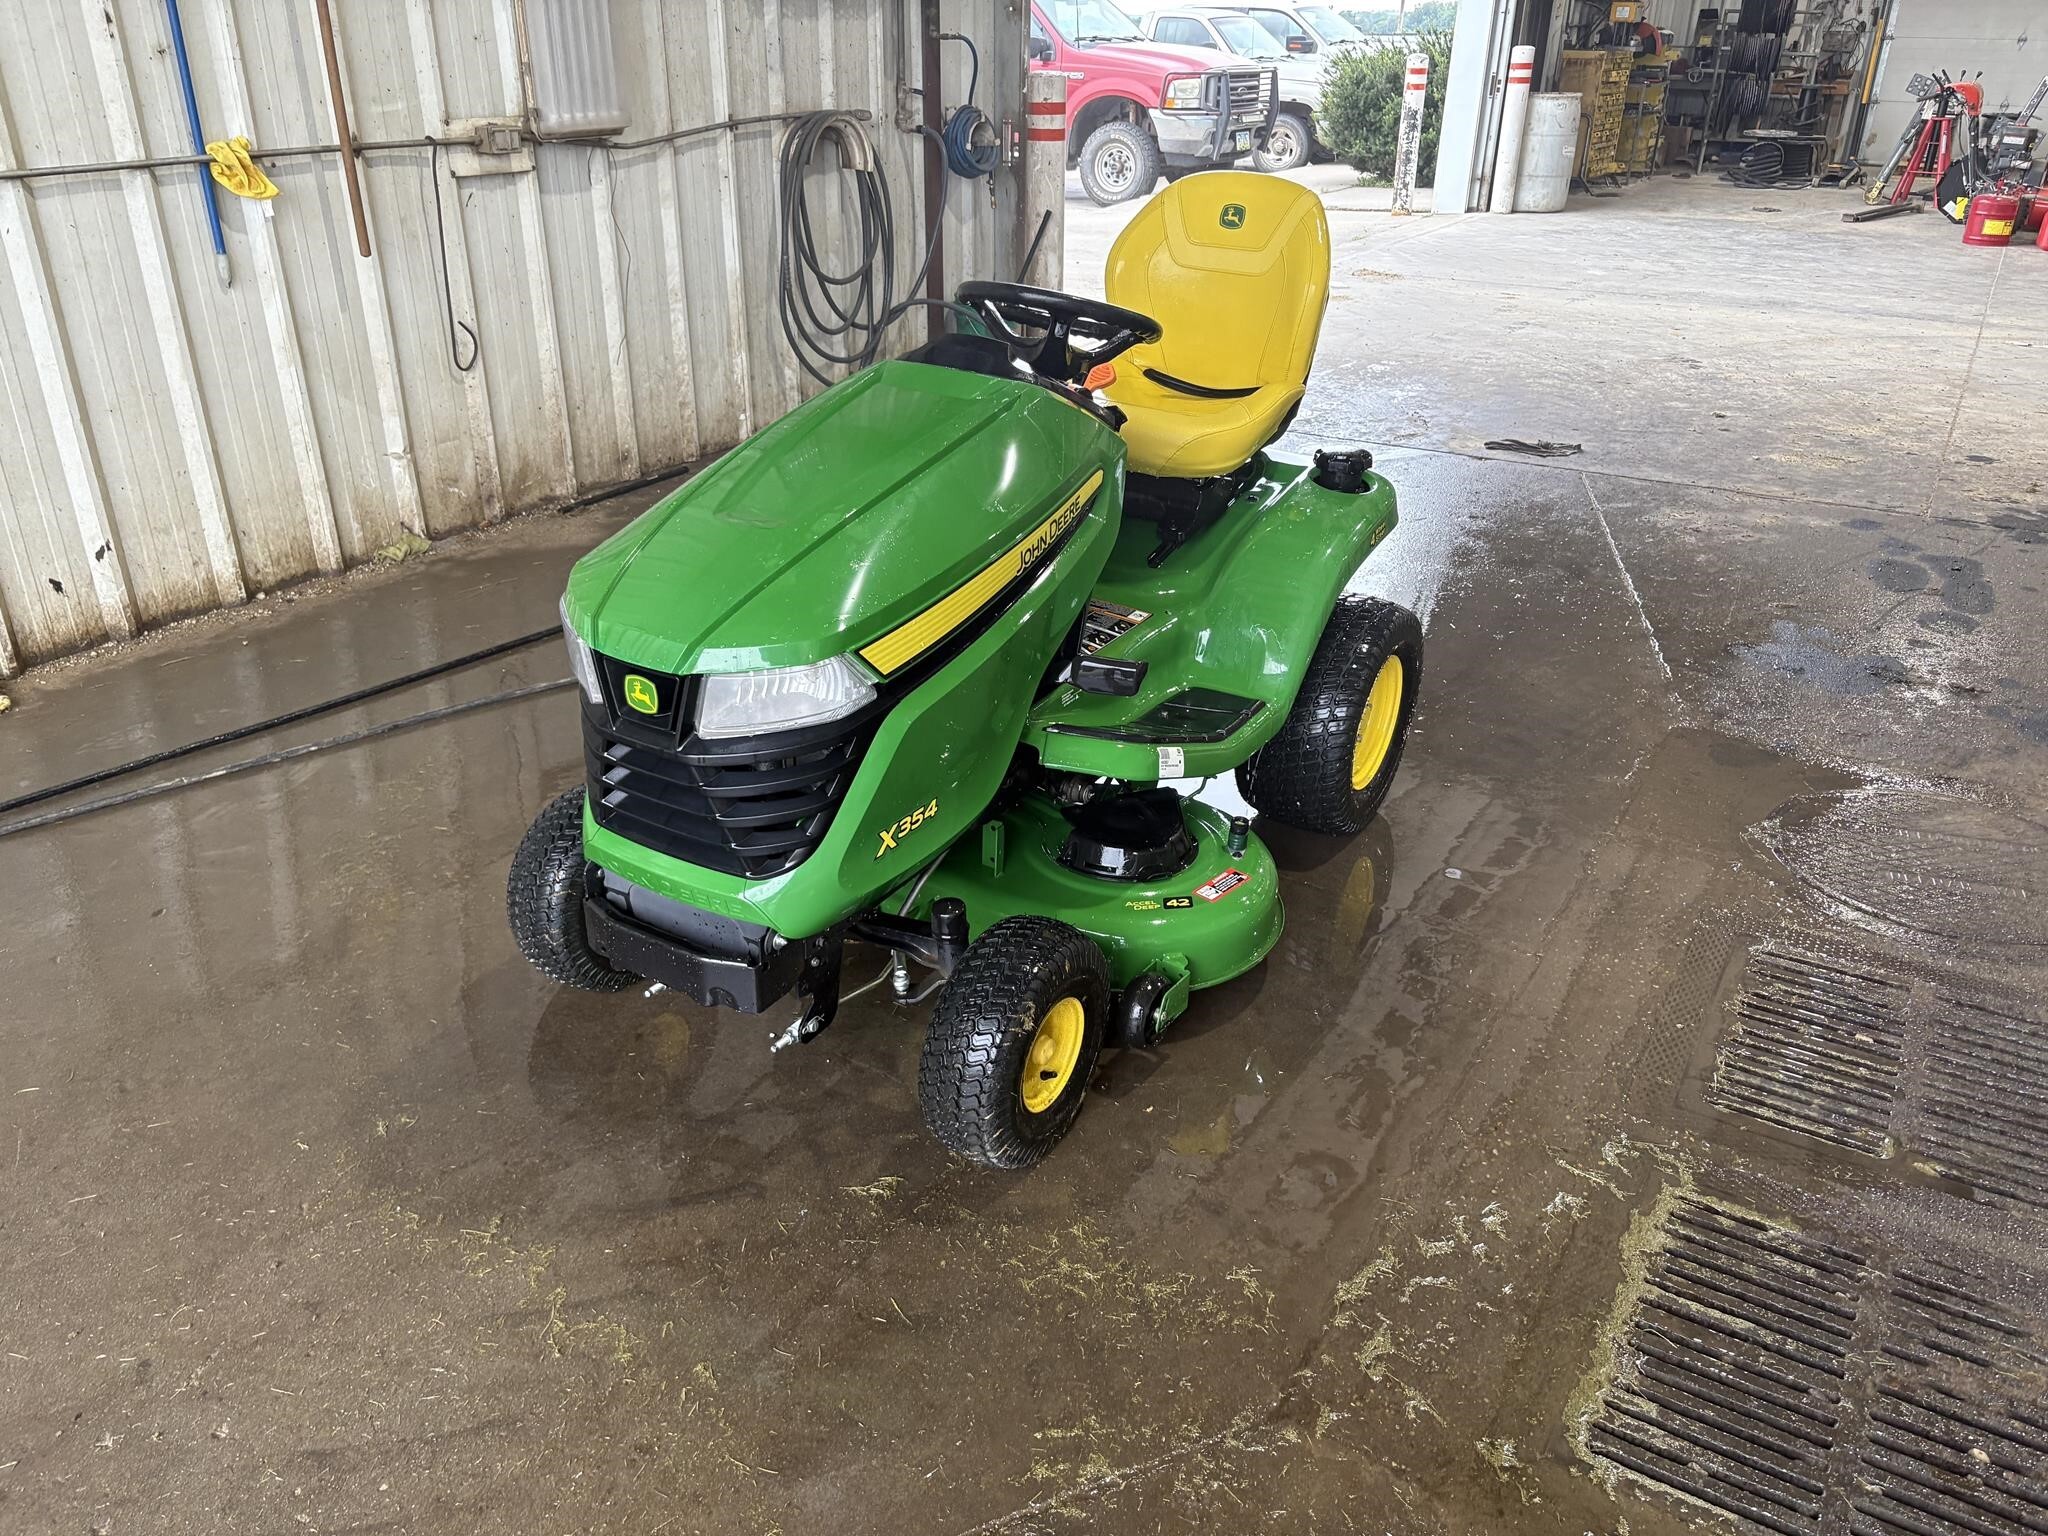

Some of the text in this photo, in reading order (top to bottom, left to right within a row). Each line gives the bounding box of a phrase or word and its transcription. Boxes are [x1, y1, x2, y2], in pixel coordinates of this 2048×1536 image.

[1016, 495, 1081, 576] JOHN DEERE
[875, 798, 938, 860] X354
[1166, 898, 1190, 907] 42
